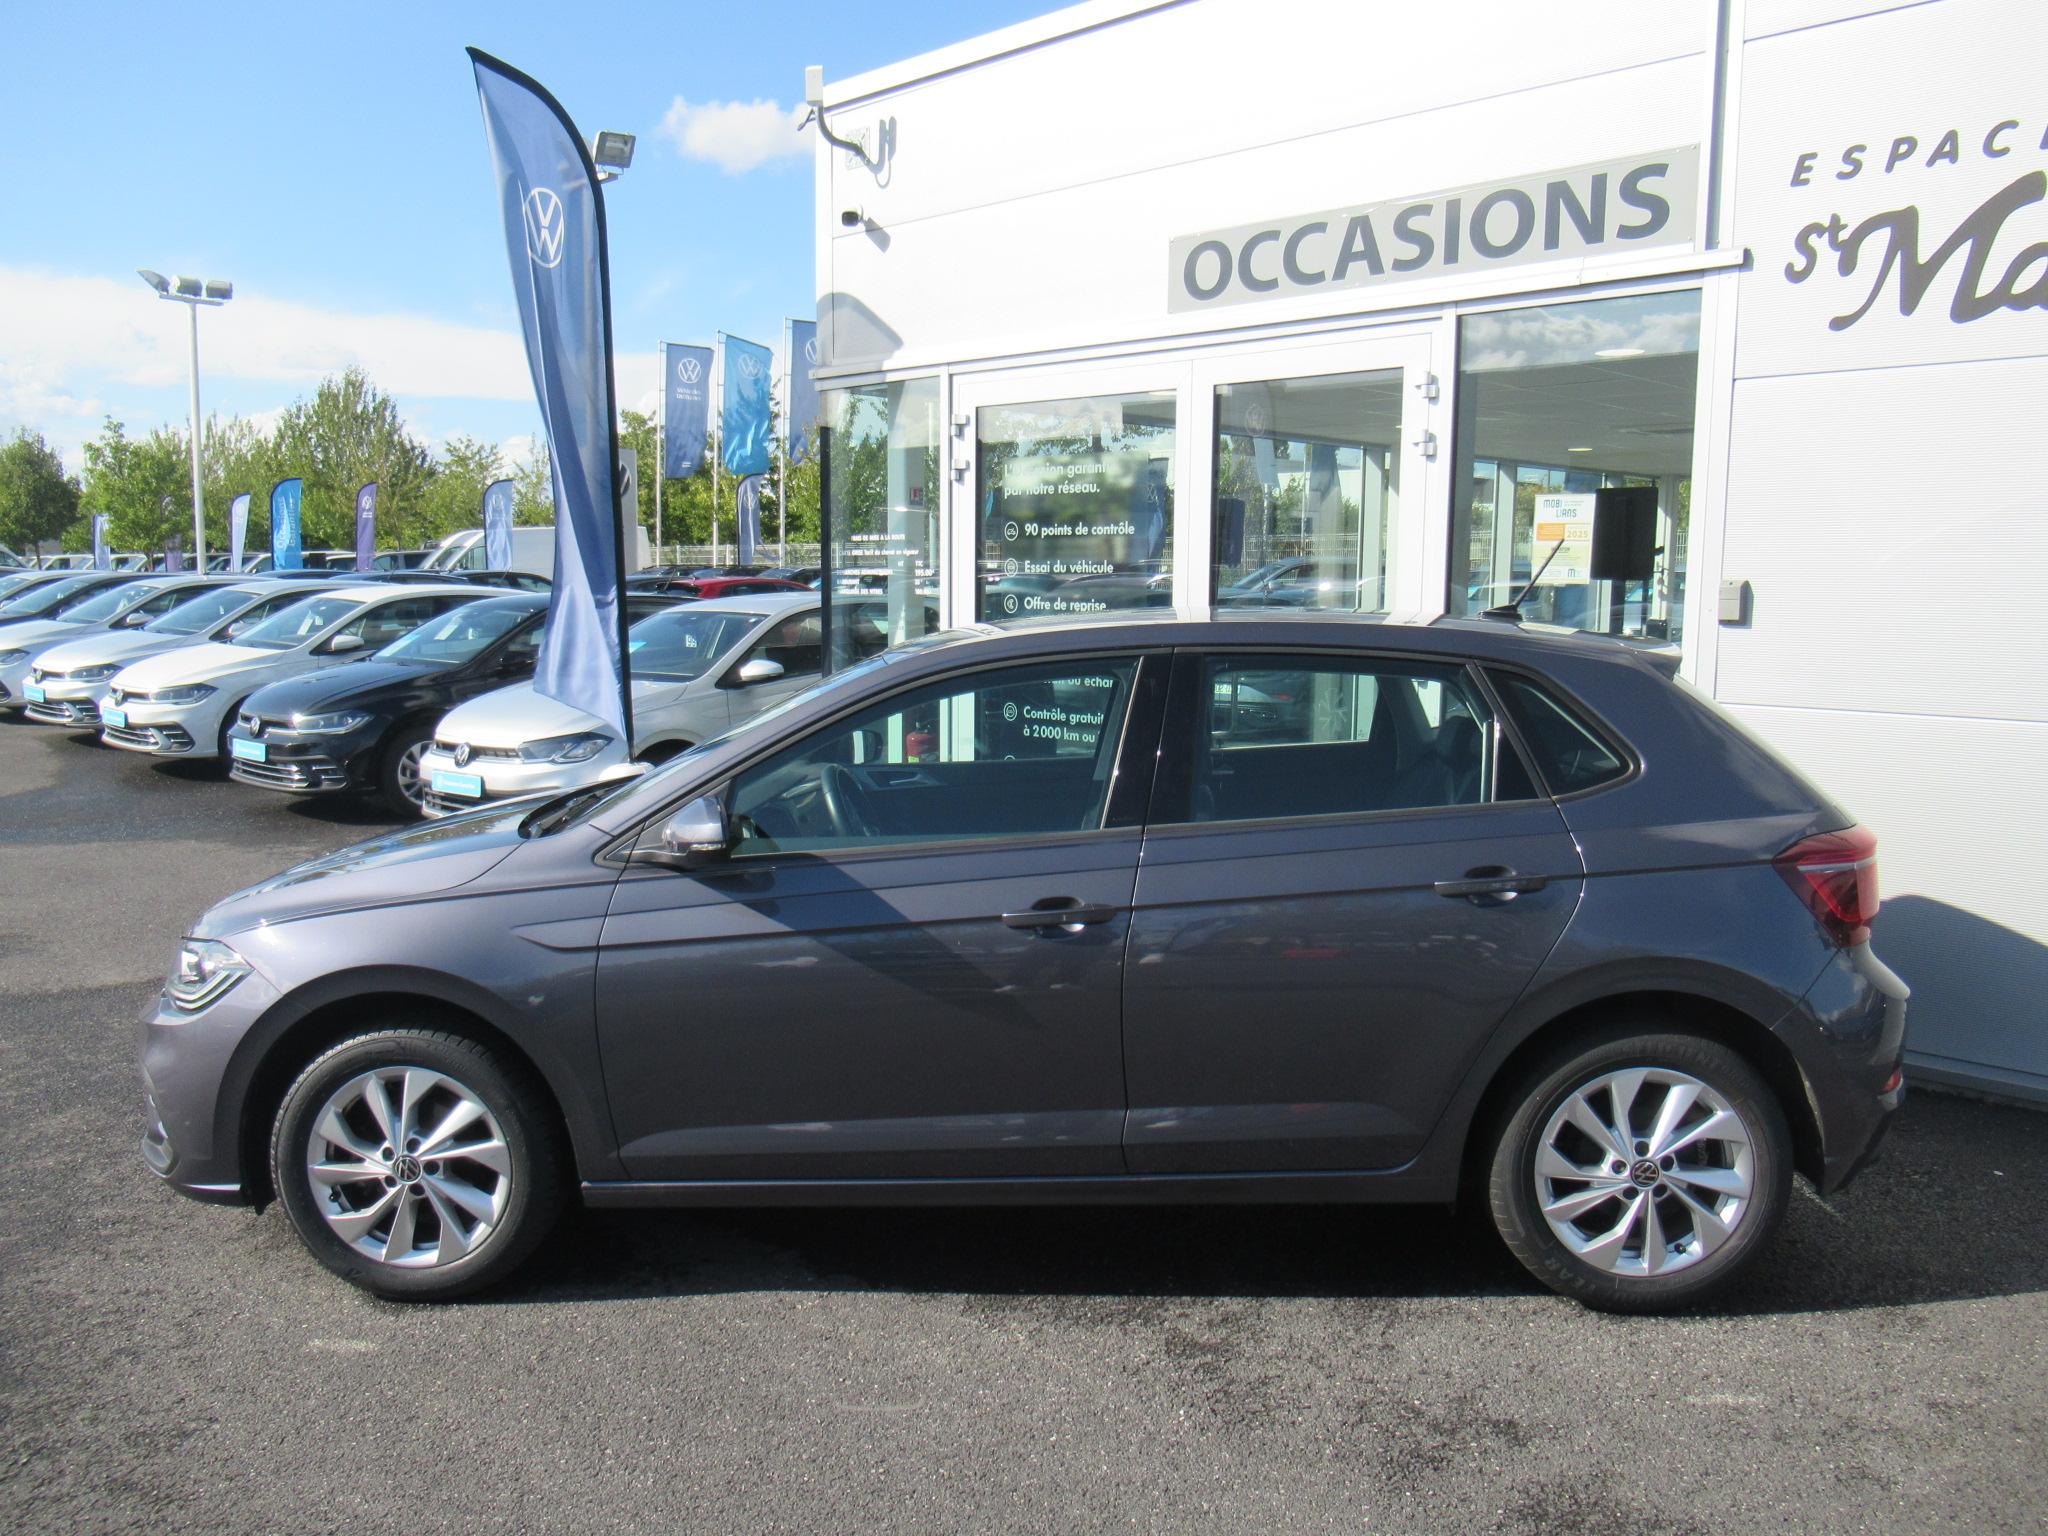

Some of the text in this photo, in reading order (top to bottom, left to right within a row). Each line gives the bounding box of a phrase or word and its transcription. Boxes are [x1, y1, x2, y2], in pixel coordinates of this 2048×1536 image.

[1183, 162, 1670, 302] OCCASIONS
[1784, 212, 1849, 284] St
[1058, 479, 1101, 494] réseau.
[1024, 520, 1136, 539] 90 points de contrôle
[1024, 559, 1114, 574] Essai du véhicule
[1023, 596, 1107, 613] Offre de reprise
[1023, 705, 1067, 722] Contrôle
[1023, 724, 1030, 737] à
[1063, 727, 1080, 742] km
[1082, 732, 1096, 743] ou
